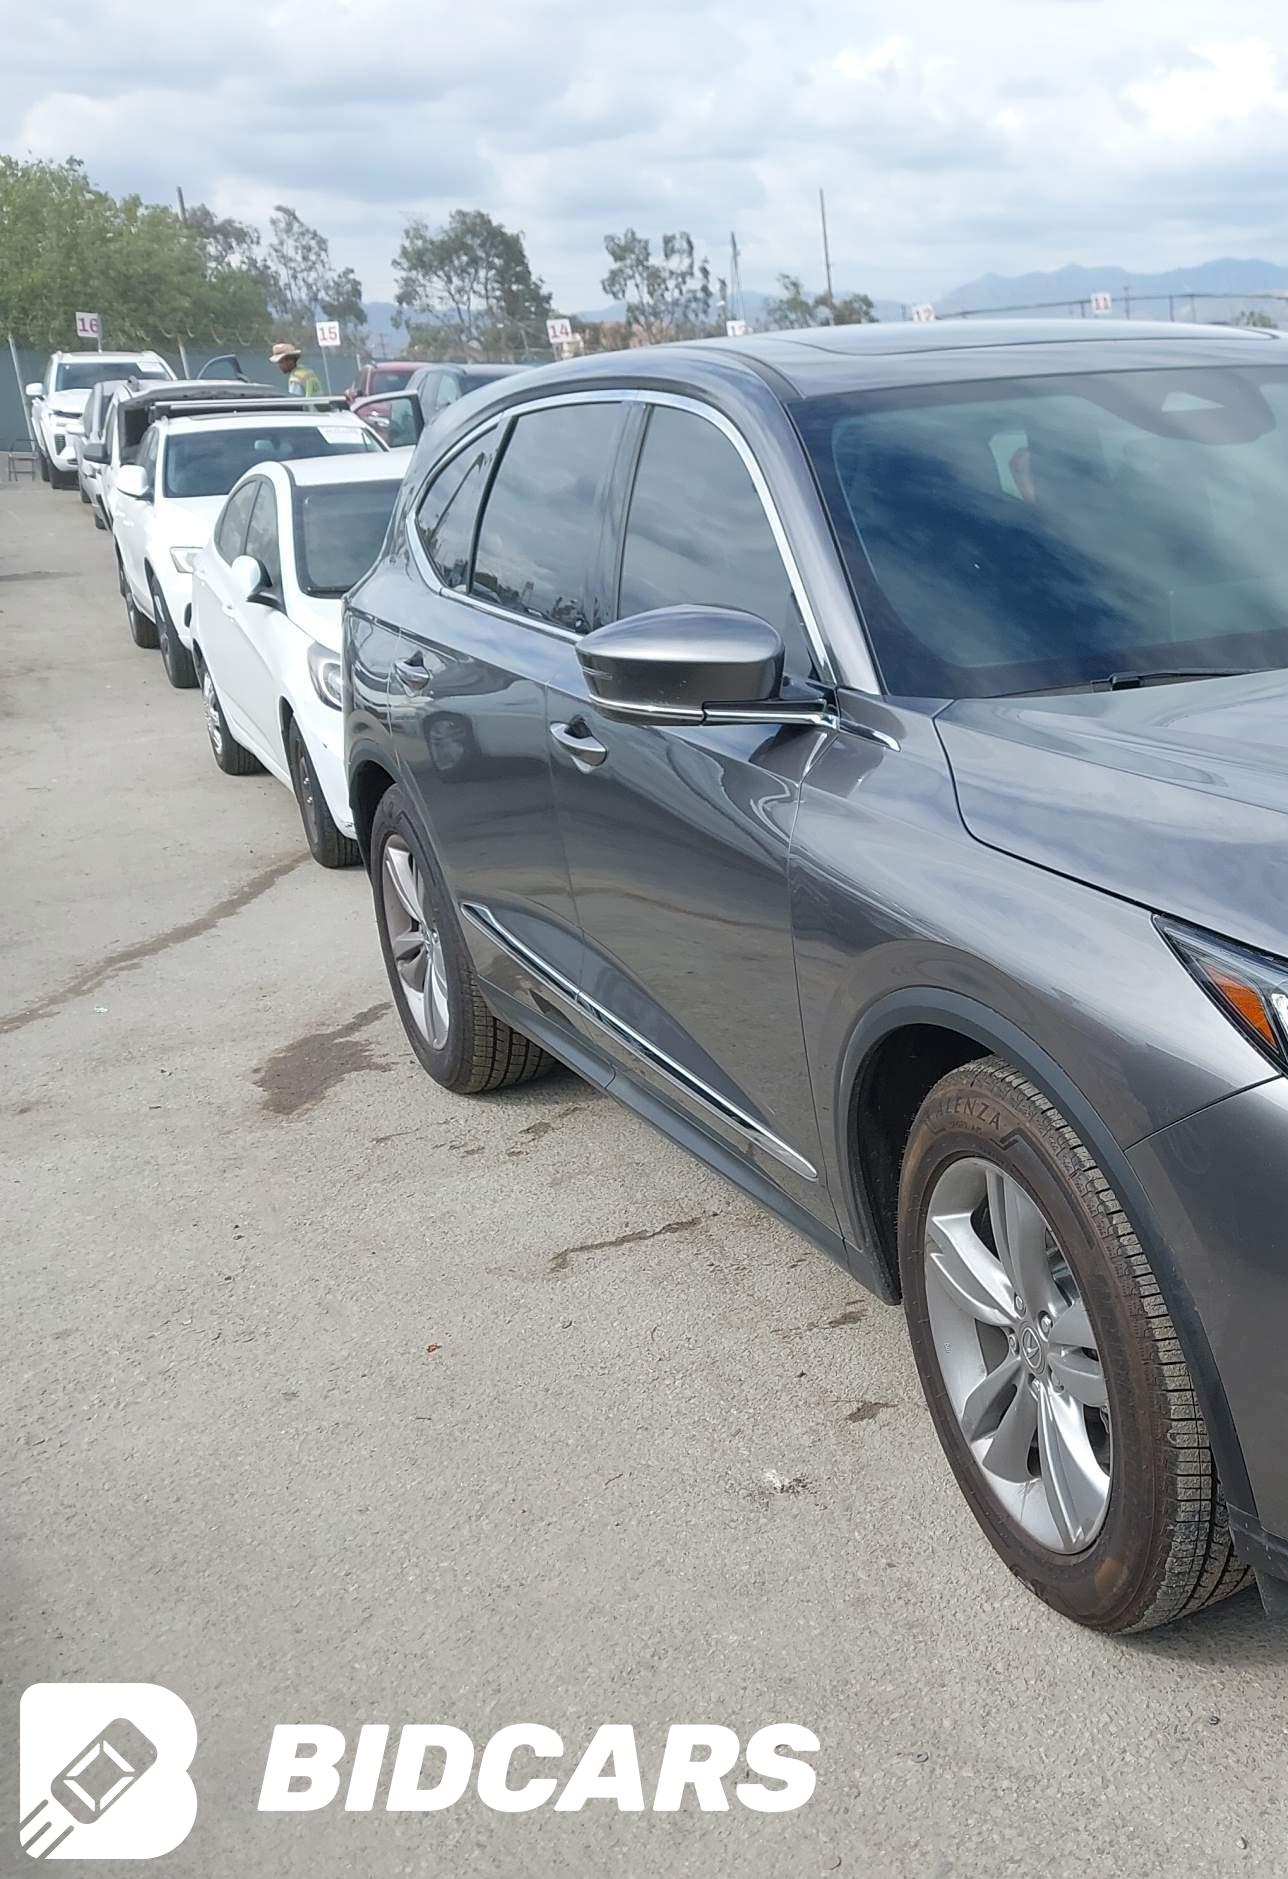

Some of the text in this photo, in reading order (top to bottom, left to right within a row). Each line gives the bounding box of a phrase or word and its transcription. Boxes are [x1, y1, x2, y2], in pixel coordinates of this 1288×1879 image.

[79, 318, 98, 333] 16
[551, 324, 569, 338] 14
[319, 327, 337, 341] 15
